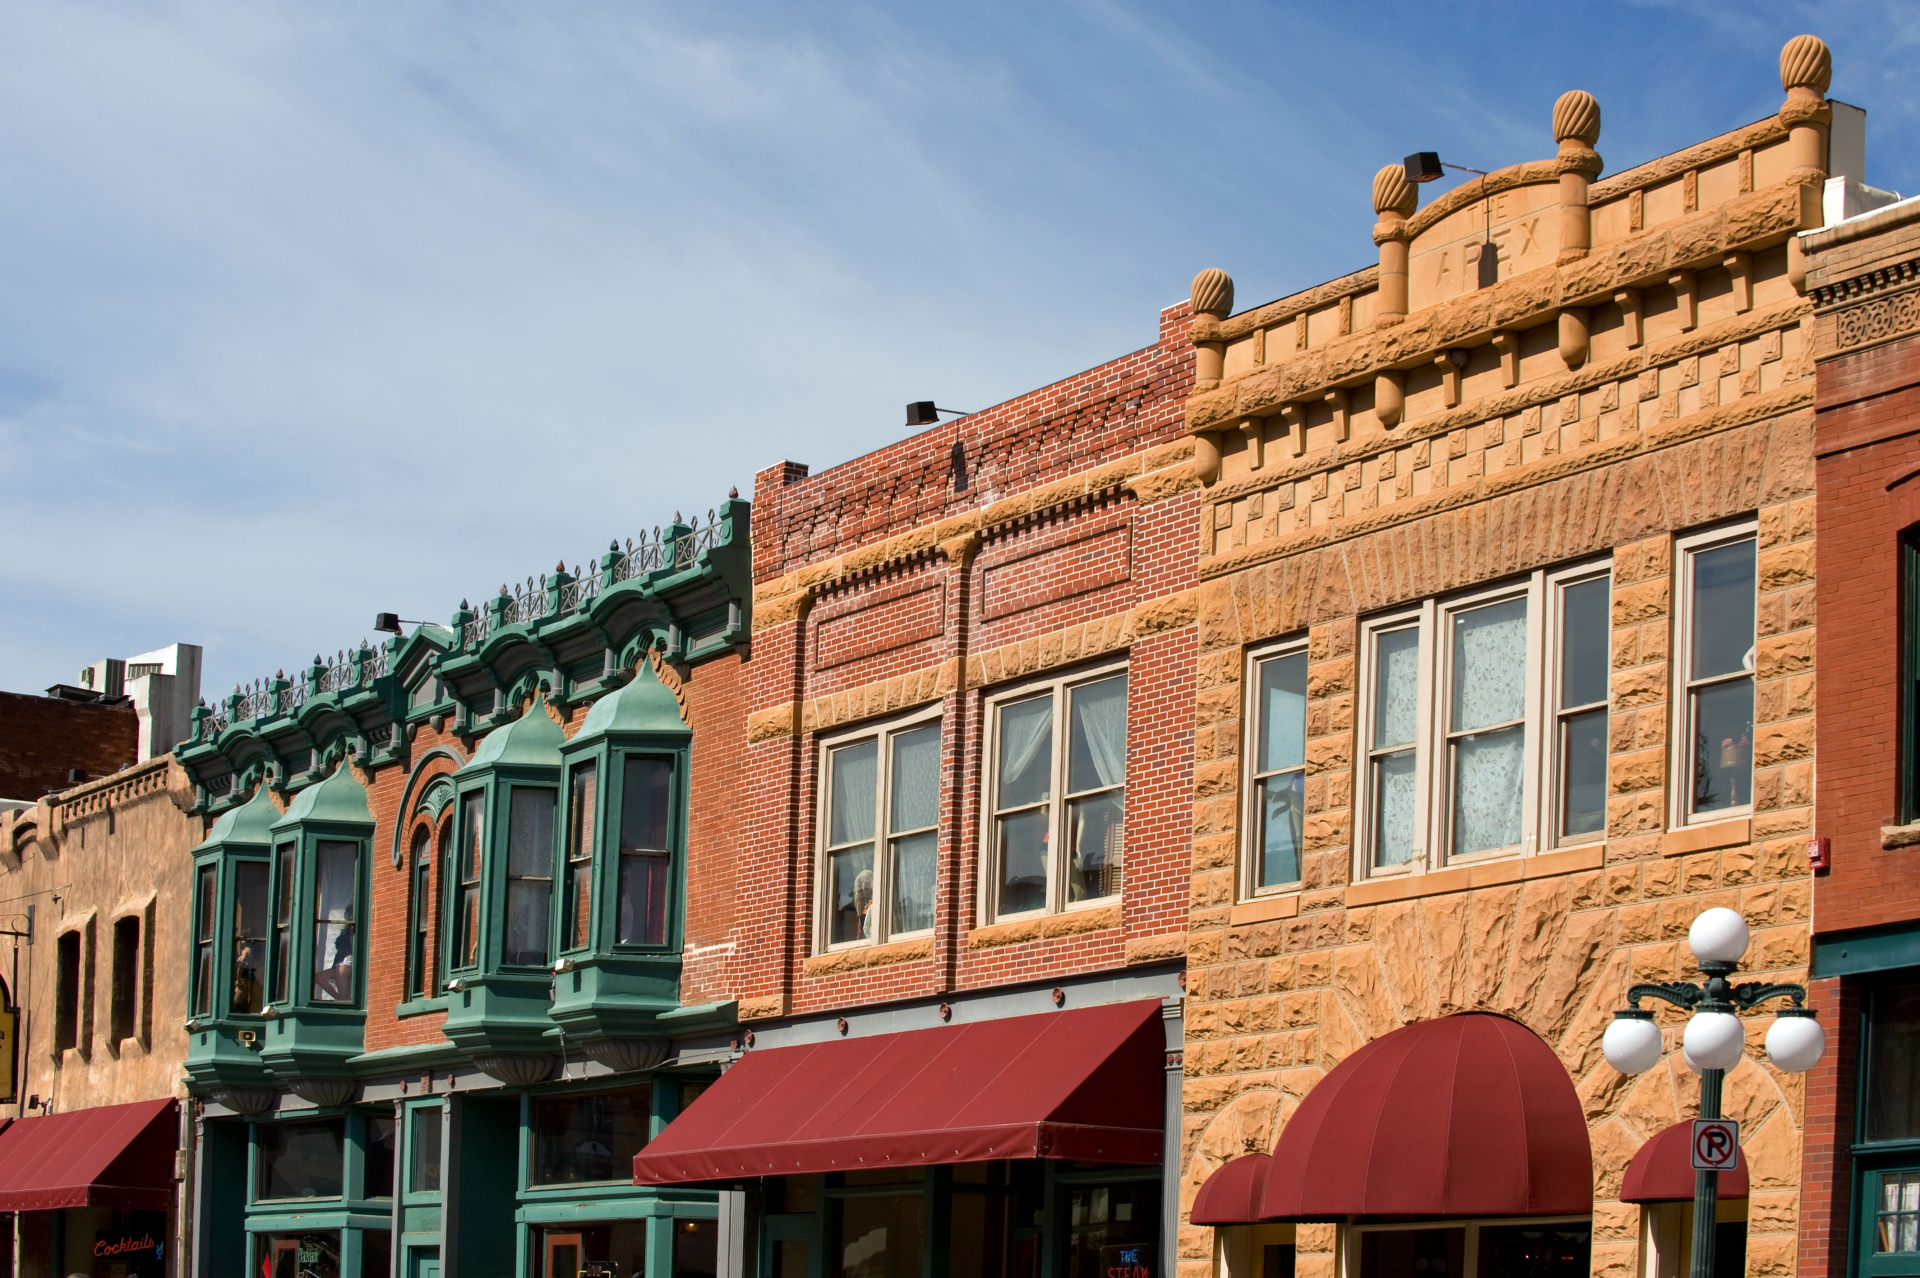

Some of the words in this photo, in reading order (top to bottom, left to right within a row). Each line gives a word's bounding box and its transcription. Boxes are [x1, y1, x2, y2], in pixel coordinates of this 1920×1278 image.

[1467, 194, 1509, 230] THE
[1435, 217, 1540, 288] APEX
[94, 1232, 155, 1257] Cocktails
[1120, 1249, 1139, 1263] THE
[1108, 1266, 1149, 1278] STEAK
